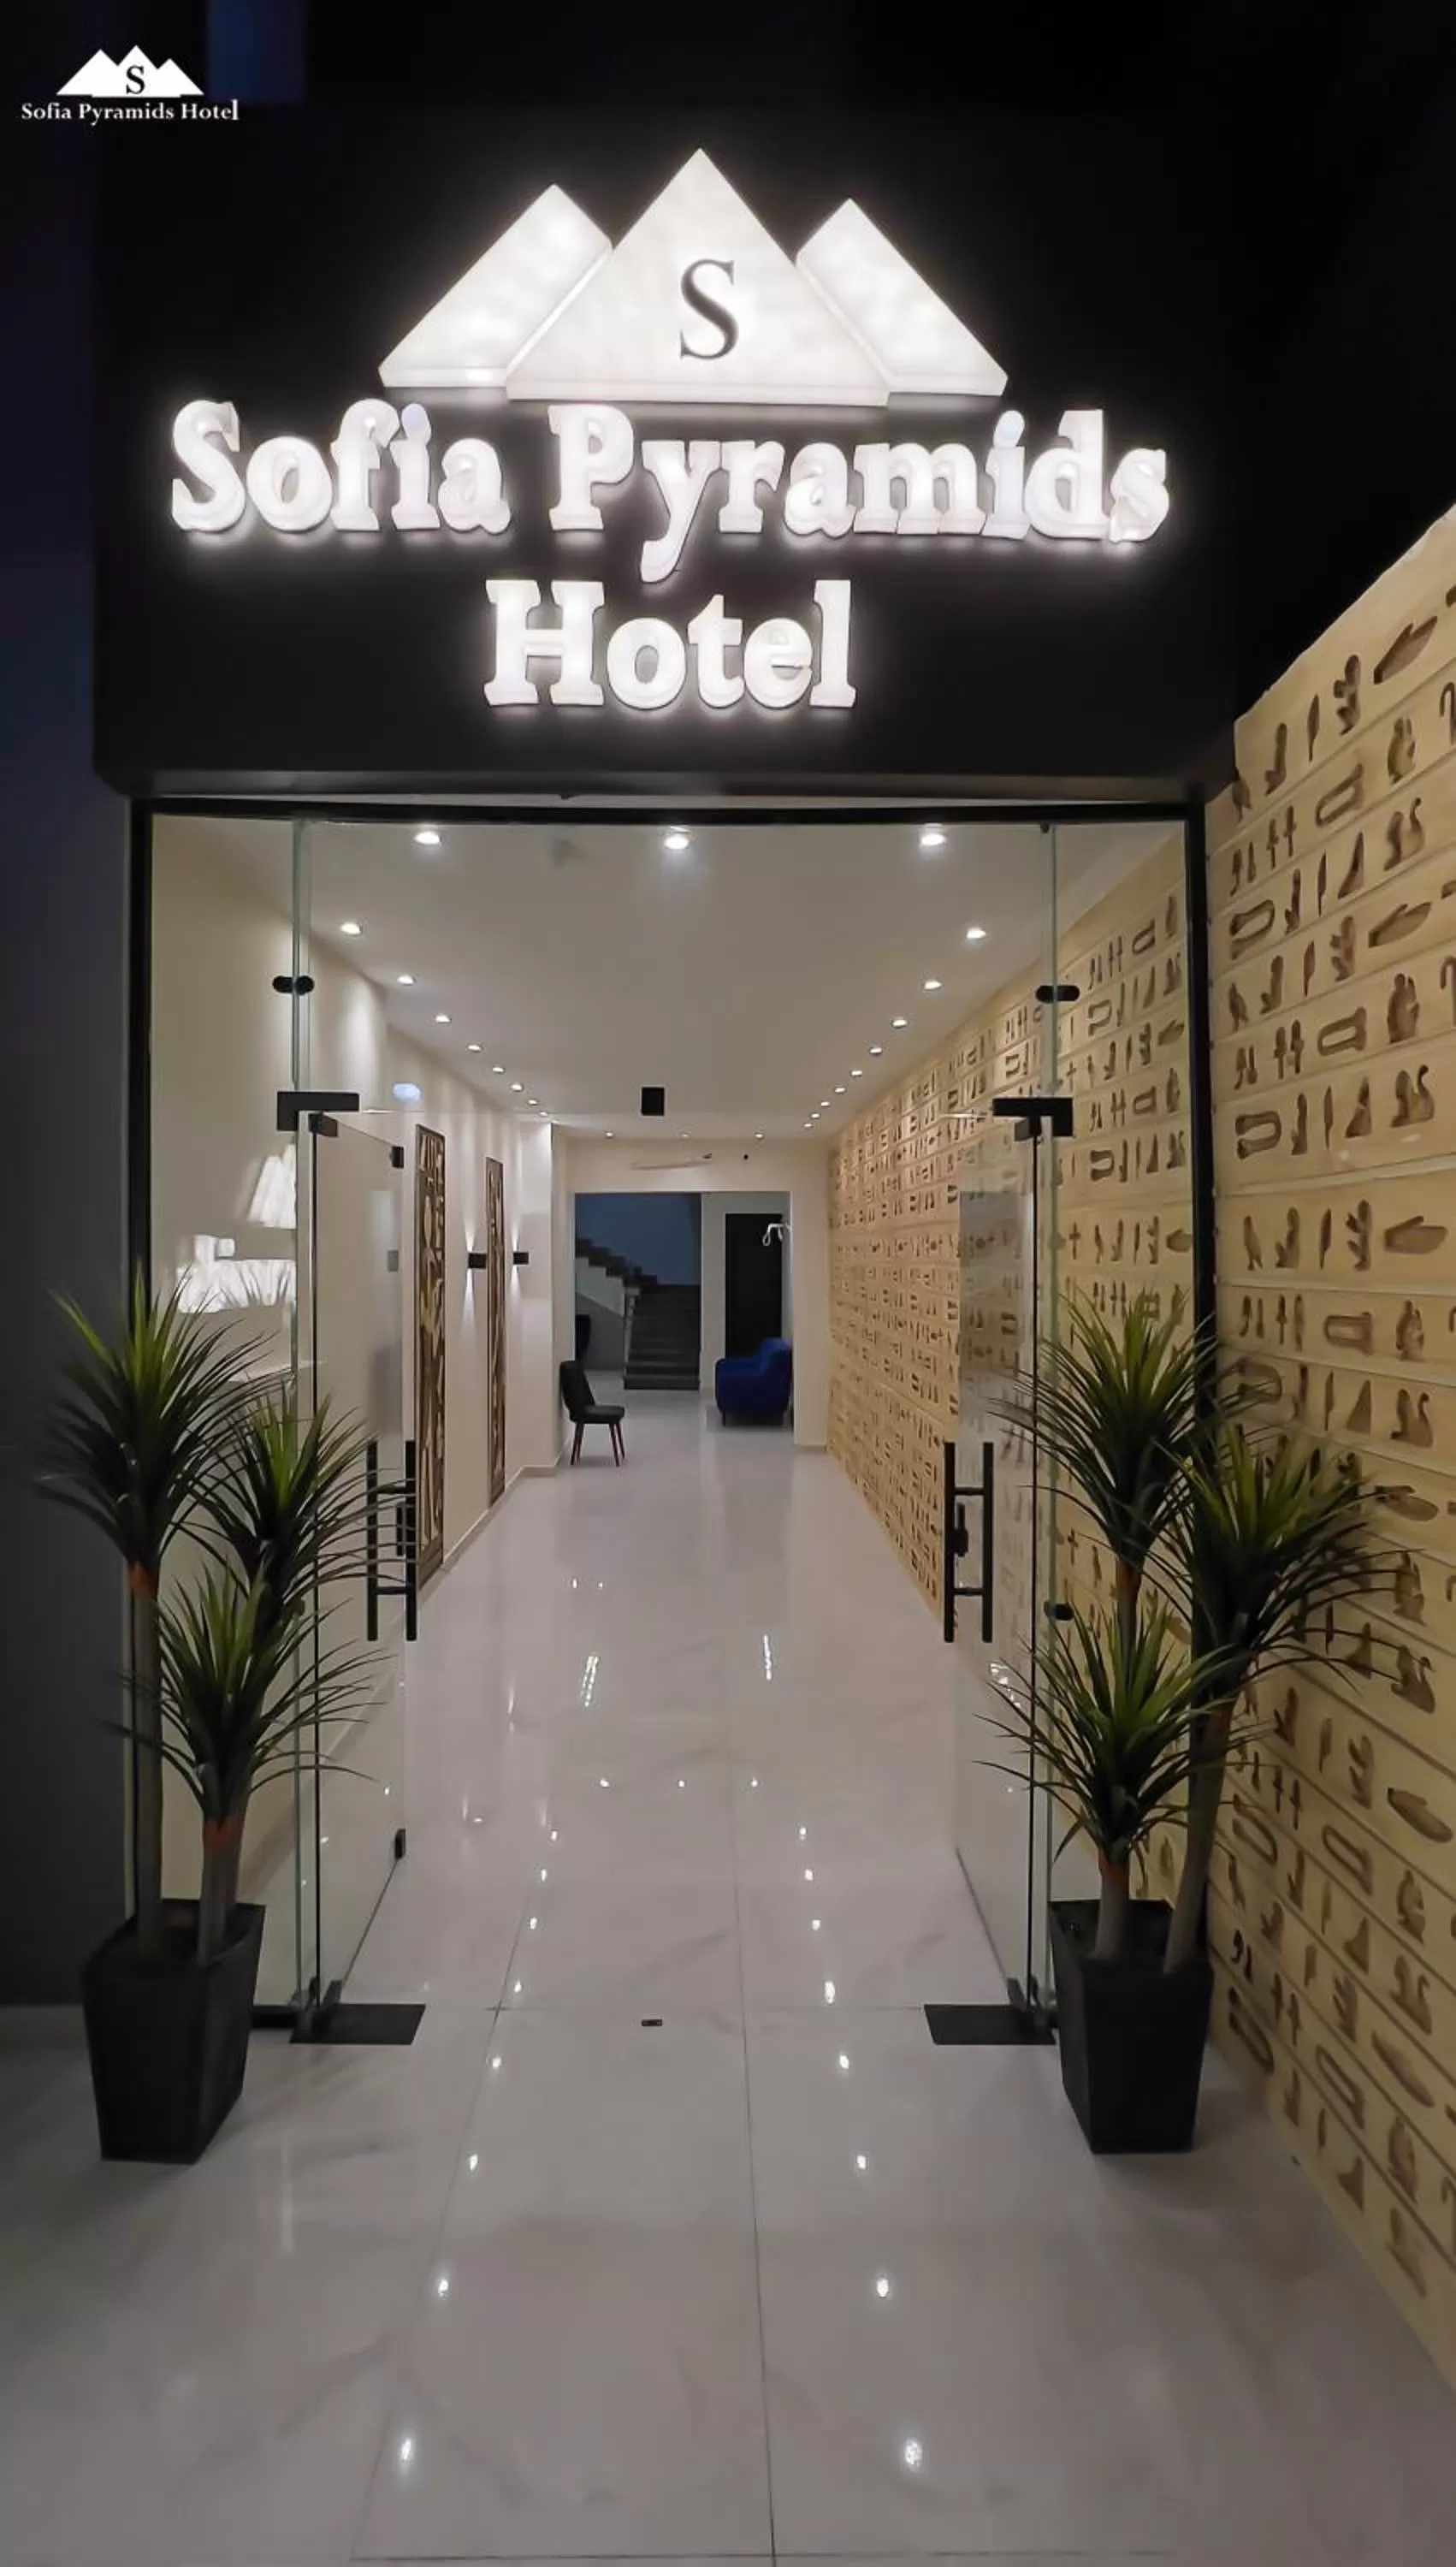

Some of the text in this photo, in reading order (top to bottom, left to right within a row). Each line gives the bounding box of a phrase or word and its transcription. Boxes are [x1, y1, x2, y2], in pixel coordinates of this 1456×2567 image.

[680, 259, 739, 359] S
[172, 399, 1170, 584] Sofia Pyramids
[484, 579, 856, 710] Hotel
